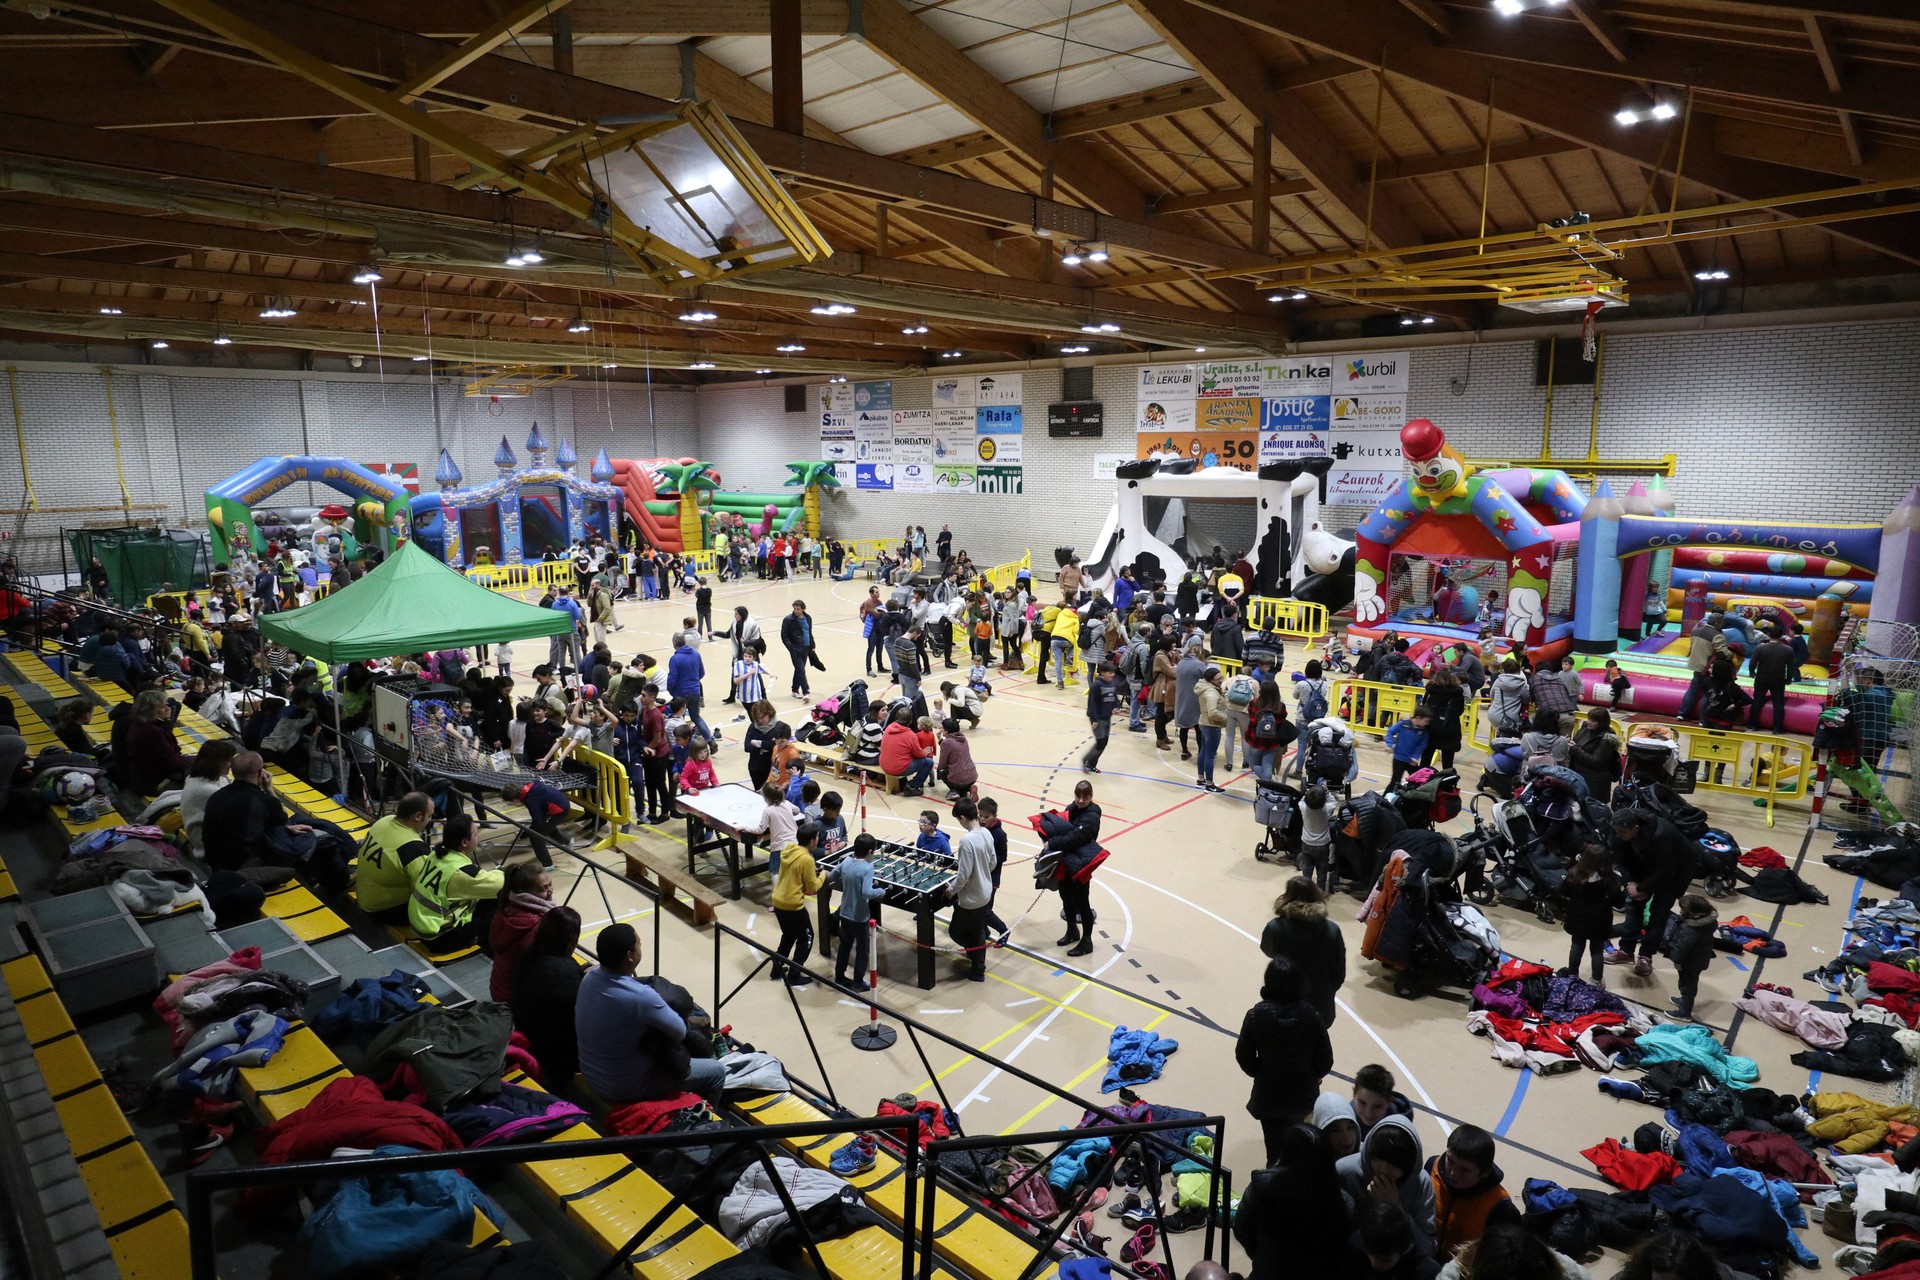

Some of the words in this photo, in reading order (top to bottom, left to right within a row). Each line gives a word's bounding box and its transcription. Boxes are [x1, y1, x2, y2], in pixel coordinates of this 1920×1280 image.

[1263, 364, 1330, 379] Tknika
[1366, 361, 1396, 376] urbil
[1157, 375, 1192, 385] LEKU-BI
[903, 411, 931, 419] ZUMITZA
[987, 410, 1013, 422] Rafa
[1346, 407, 1401, 416] LABE-GOXO
[1147, 444, 1162, 456] 1963
[1222, 440, 1255, 459] 50
[1264, 441, 1293, 449] ENRIQUE
[1296, 440, 1325, 448] ALONSO
[1358, 445, 1401, 457] kutxa
[978, 474, 1022, 493] mur
[1336, 472, 1384, 486] Laurok
[1649, 523, 1839, 556] colorines
[418, 857, 443, 896] YA
